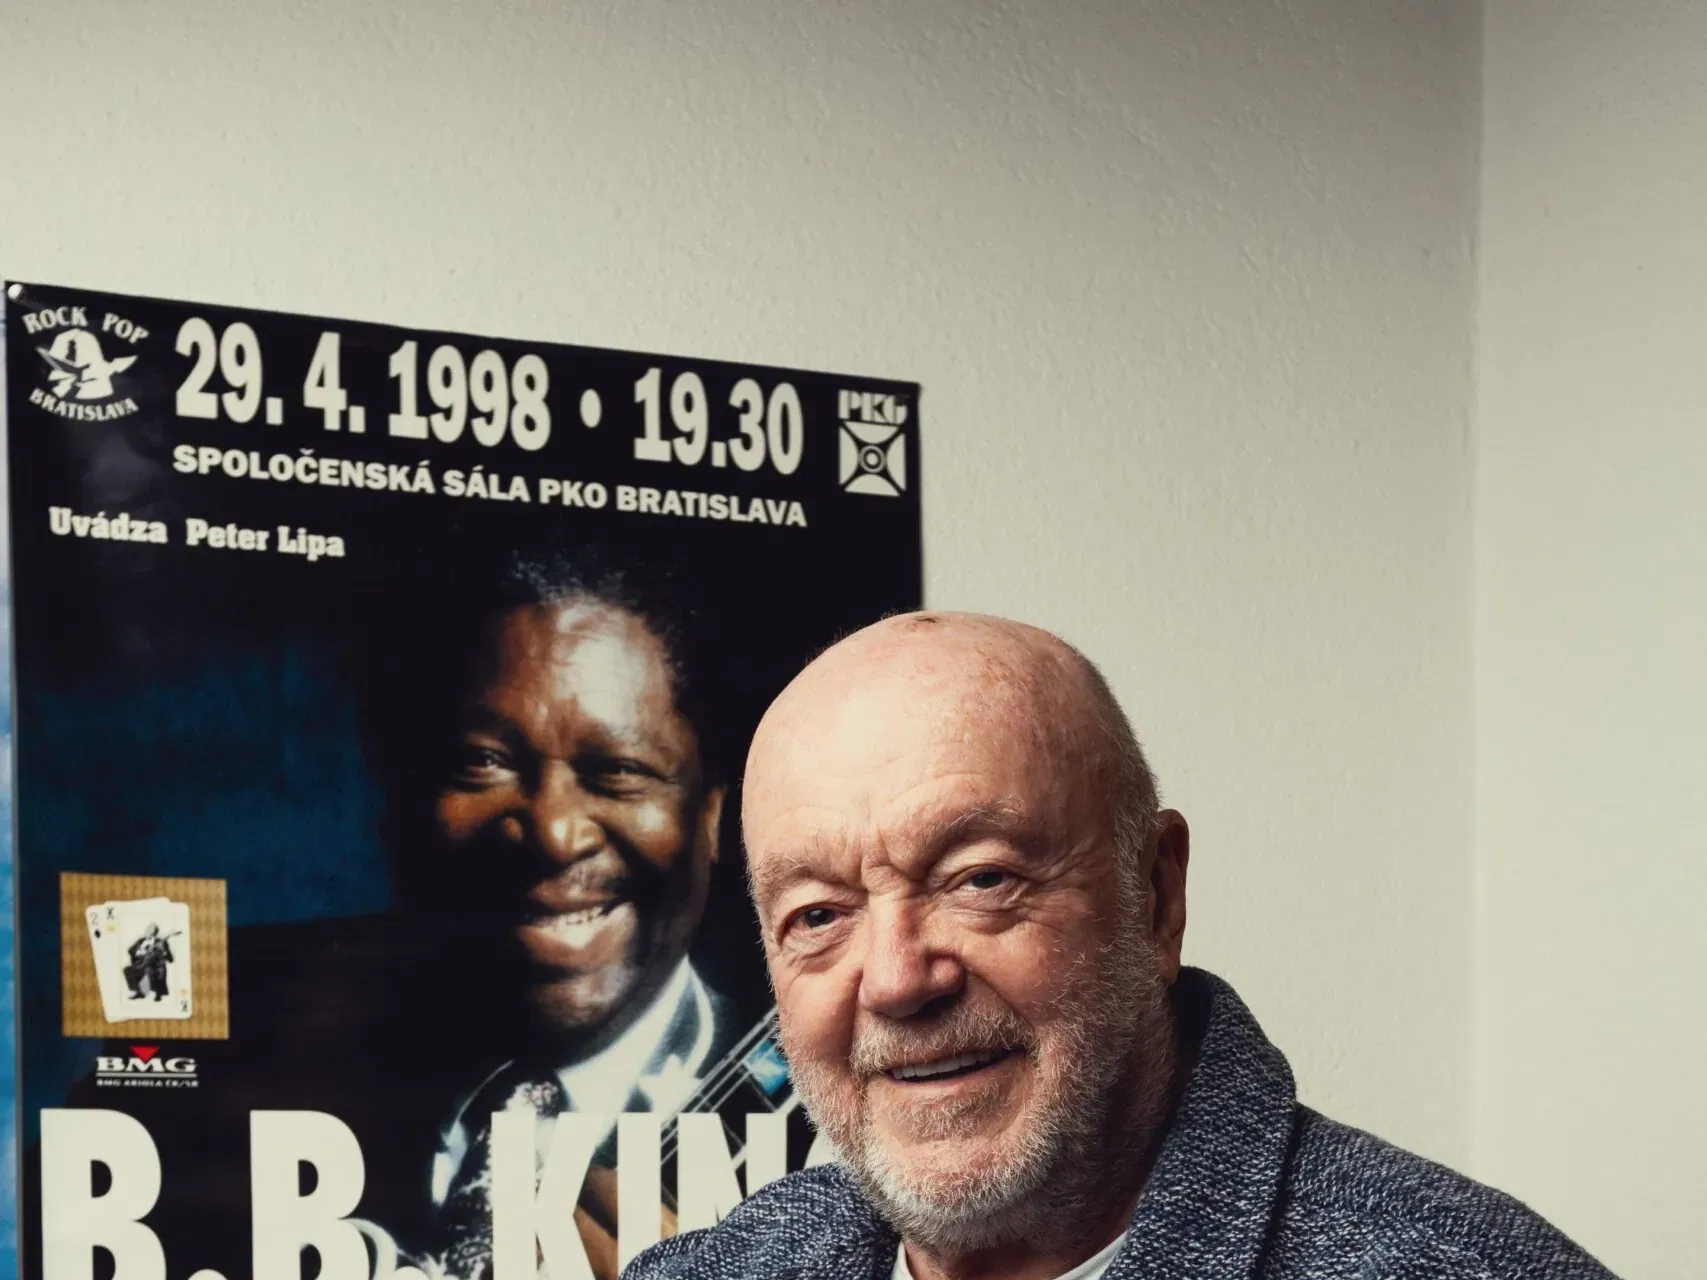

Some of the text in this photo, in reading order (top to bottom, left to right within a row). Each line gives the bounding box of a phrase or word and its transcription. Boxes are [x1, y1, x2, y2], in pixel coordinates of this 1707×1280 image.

[22, 306, 149, 344] ROCK POP
[28, 388, 139, 421] BRATISLAVA
[175, 316, 283, 425] 29.
[303, 331, 366, 433] 4.
[388, 340, 551, 450] 1998
[633, 367, 804, 475] 19.30
[172, 444, 808, 527] SPOLOČENSKÁ SÁLA PKO BRATISLAVA
[49, 506, 346, 560] Uvádza Peter Lipa
[96, 1056, 197, 1073] BMG
